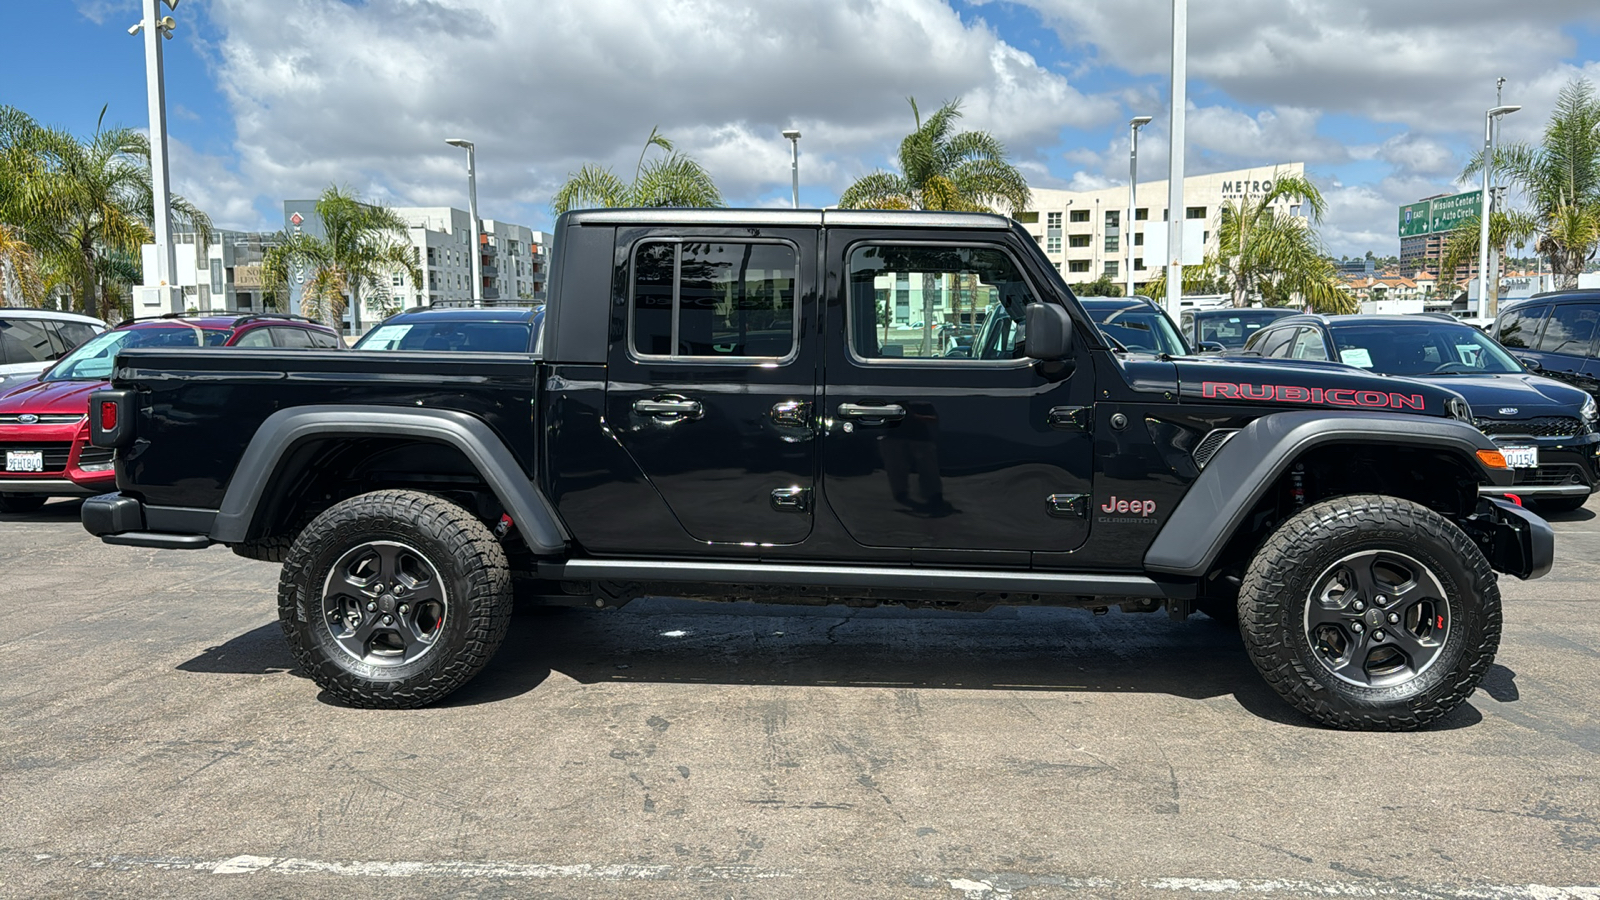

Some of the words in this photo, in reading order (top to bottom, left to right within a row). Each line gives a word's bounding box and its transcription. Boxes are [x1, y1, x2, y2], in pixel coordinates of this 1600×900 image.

[1222, 180, 1272, 193] METRO
[1433, 200, 1455, 211] Mission
[1455, 195, 1475, 207] Center
[1413, 211, 1424, 219] EAST
[1442, 211, 1456, 221] Auto
[1457, 208, 1474, 218] Circle
[1202, 381, 1425, 410] RUBICON
[9, 458, 40, 469] 9FHT840
[1101, 496, 1156, 517] Jeep
[1098, 516, 1158, 524] GLADIATOR
